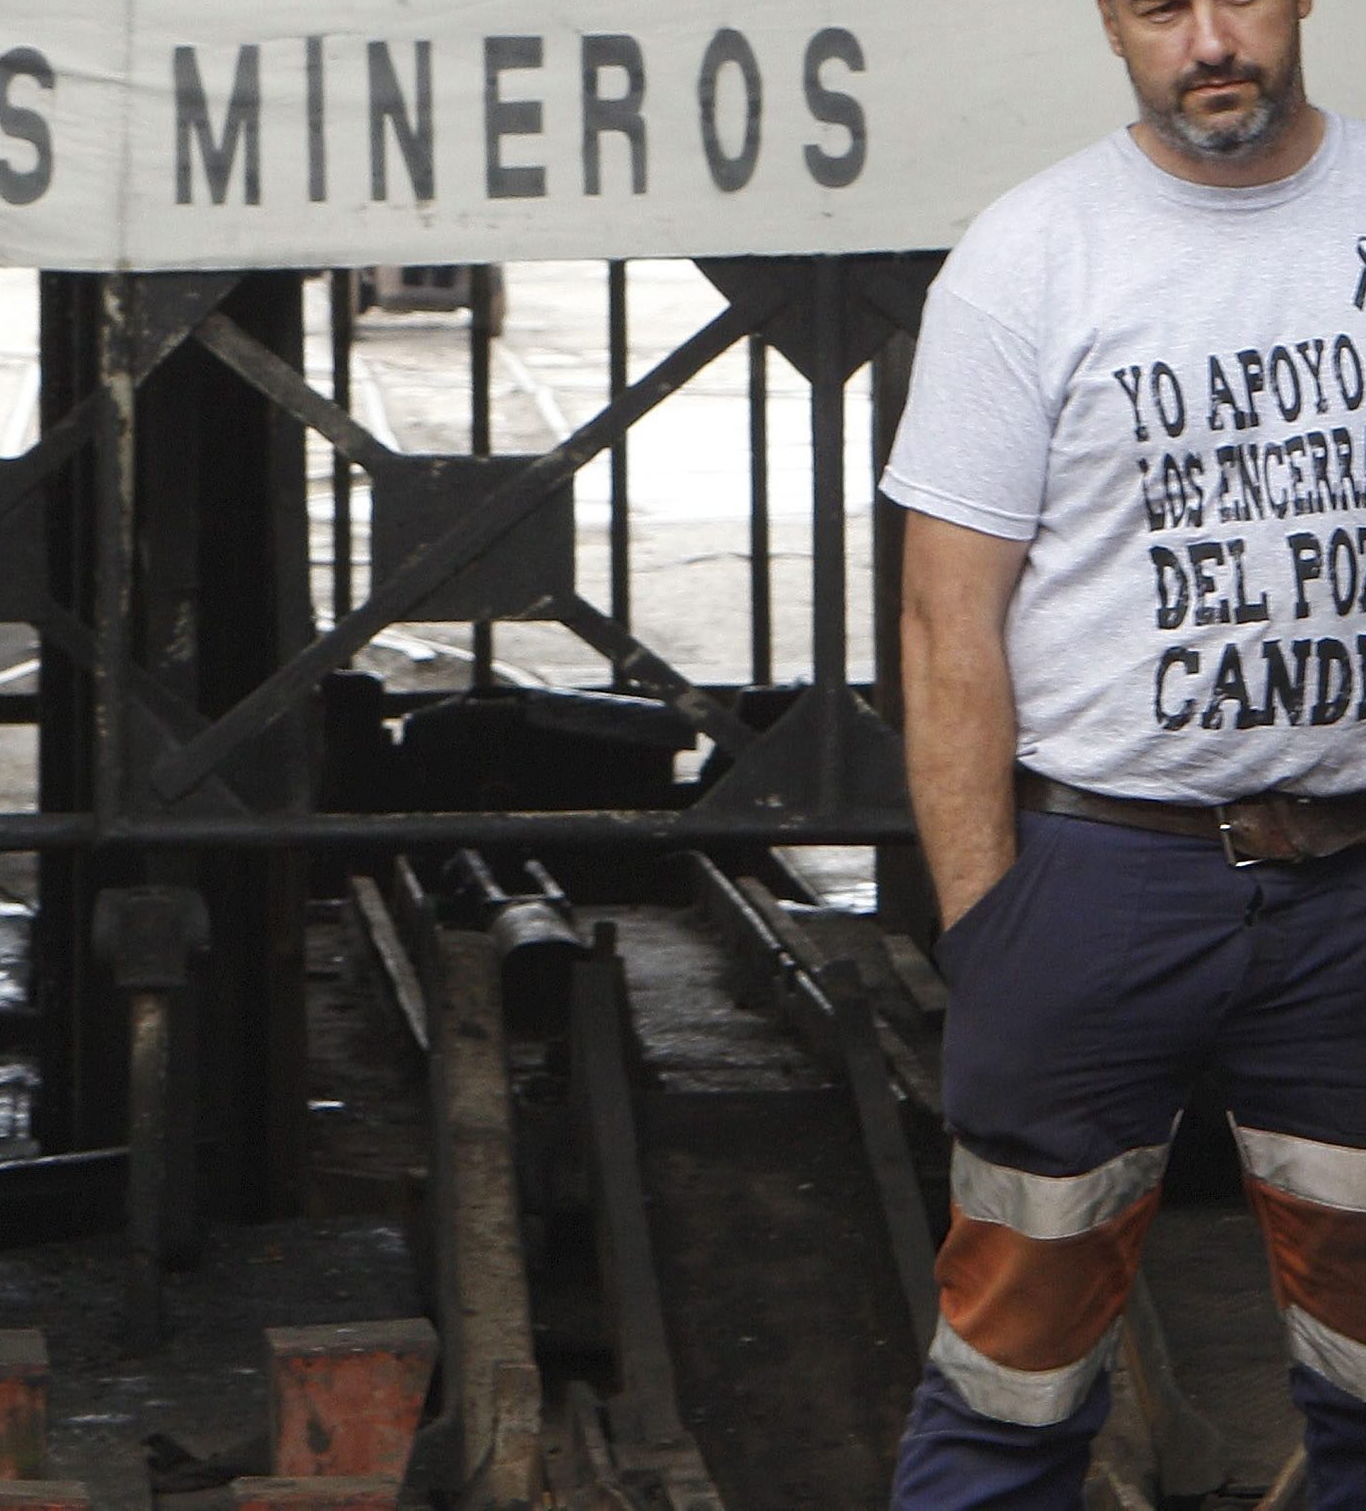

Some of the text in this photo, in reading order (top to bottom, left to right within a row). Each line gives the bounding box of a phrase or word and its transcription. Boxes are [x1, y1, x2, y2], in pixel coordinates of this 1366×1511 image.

[174, 27, 868, 206] MINEROS
[1112, 361, 1187, 443] YO
[1206, 334, 1366, 432] APOYO
[1138, 451, 1205, 532] LOS
[1149, 538, 1269, 630] DEL
